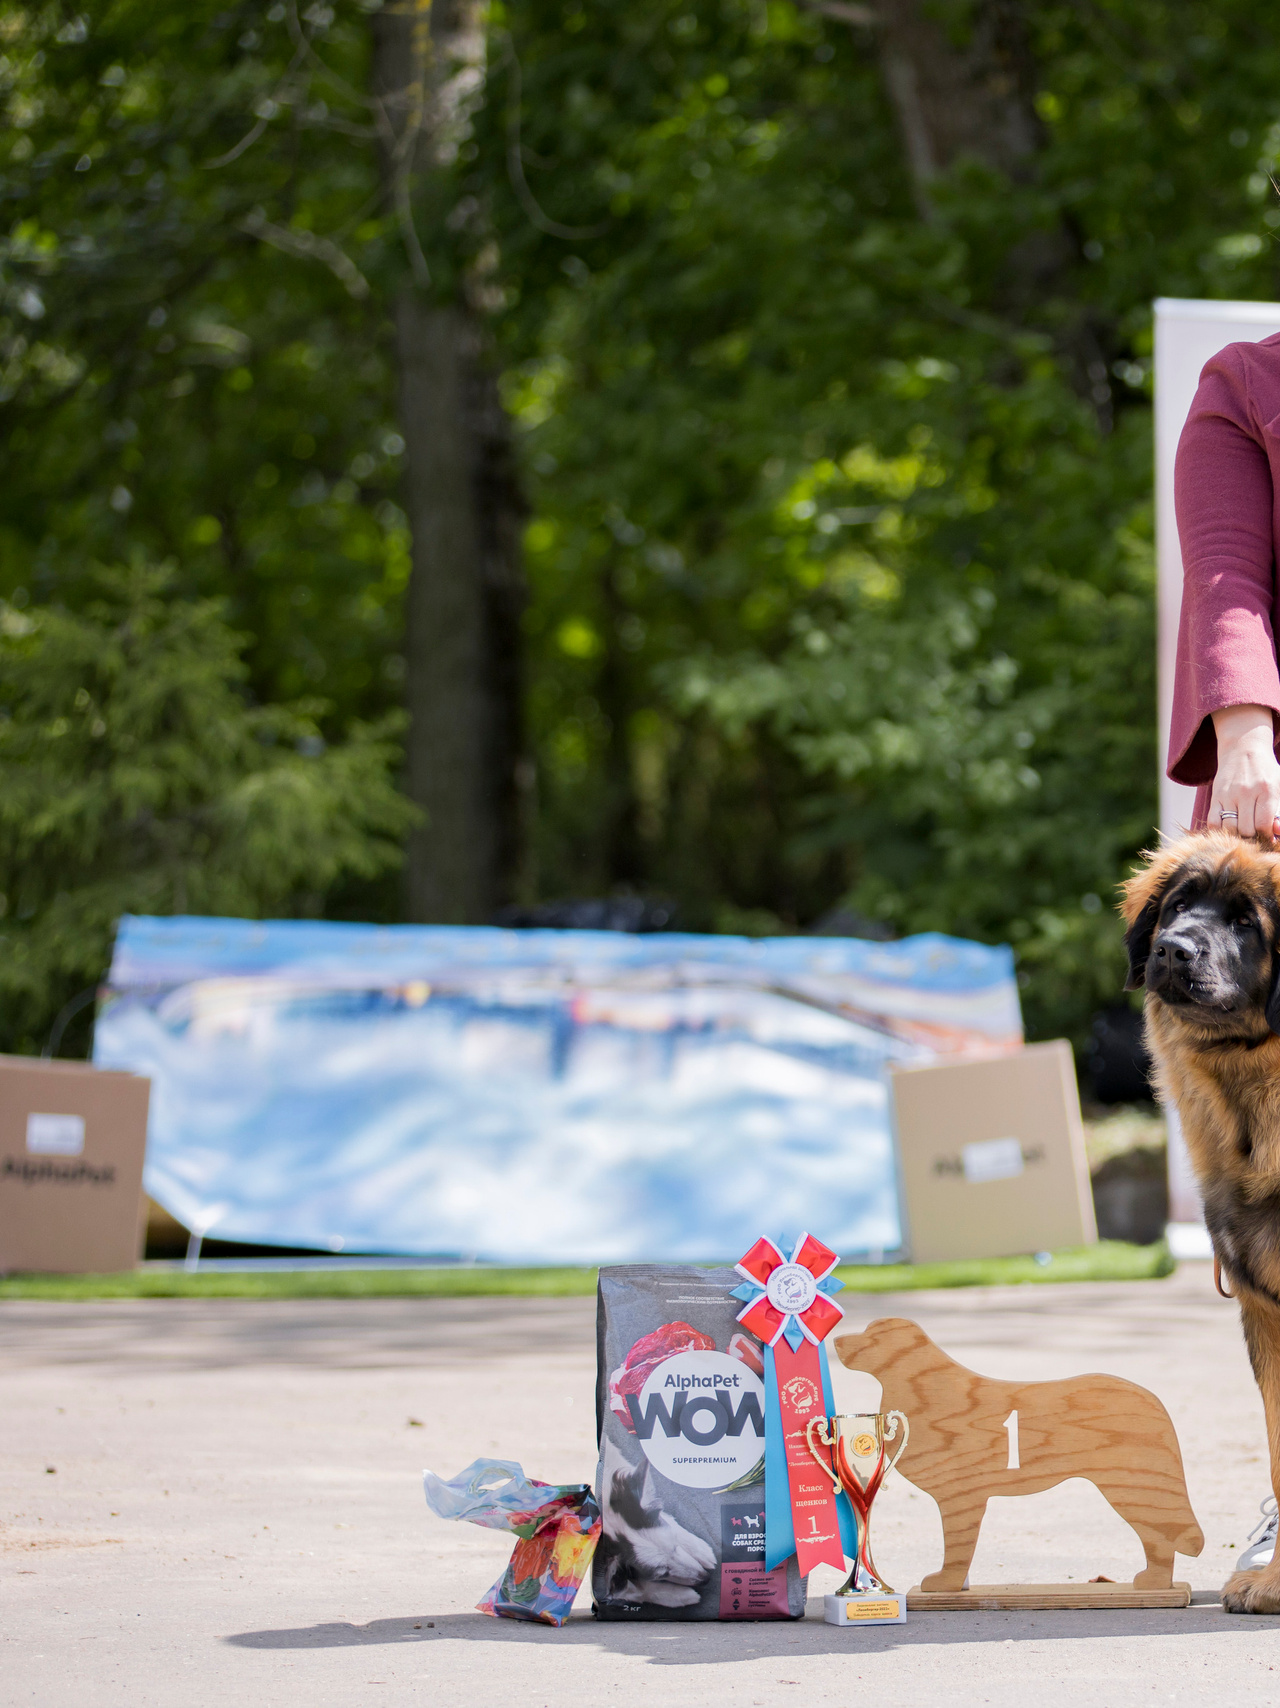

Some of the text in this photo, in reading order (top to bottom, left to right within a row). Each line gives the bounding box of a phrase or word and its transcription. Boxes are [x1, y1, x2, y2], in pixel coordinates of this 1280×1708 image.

[664, 1373, 740, 1391] AlphaPet
[625, 1389, 765, 1447] WOW
[1003, 1409, 1020, 1469] 1
[672, 1456, 737, 1464] SUPERPREMIUM
[798, 1484, 824, 1493] Класс
[795, 1499, 828, 1507] щенков
[808, 1515, 820, 1535] 1
